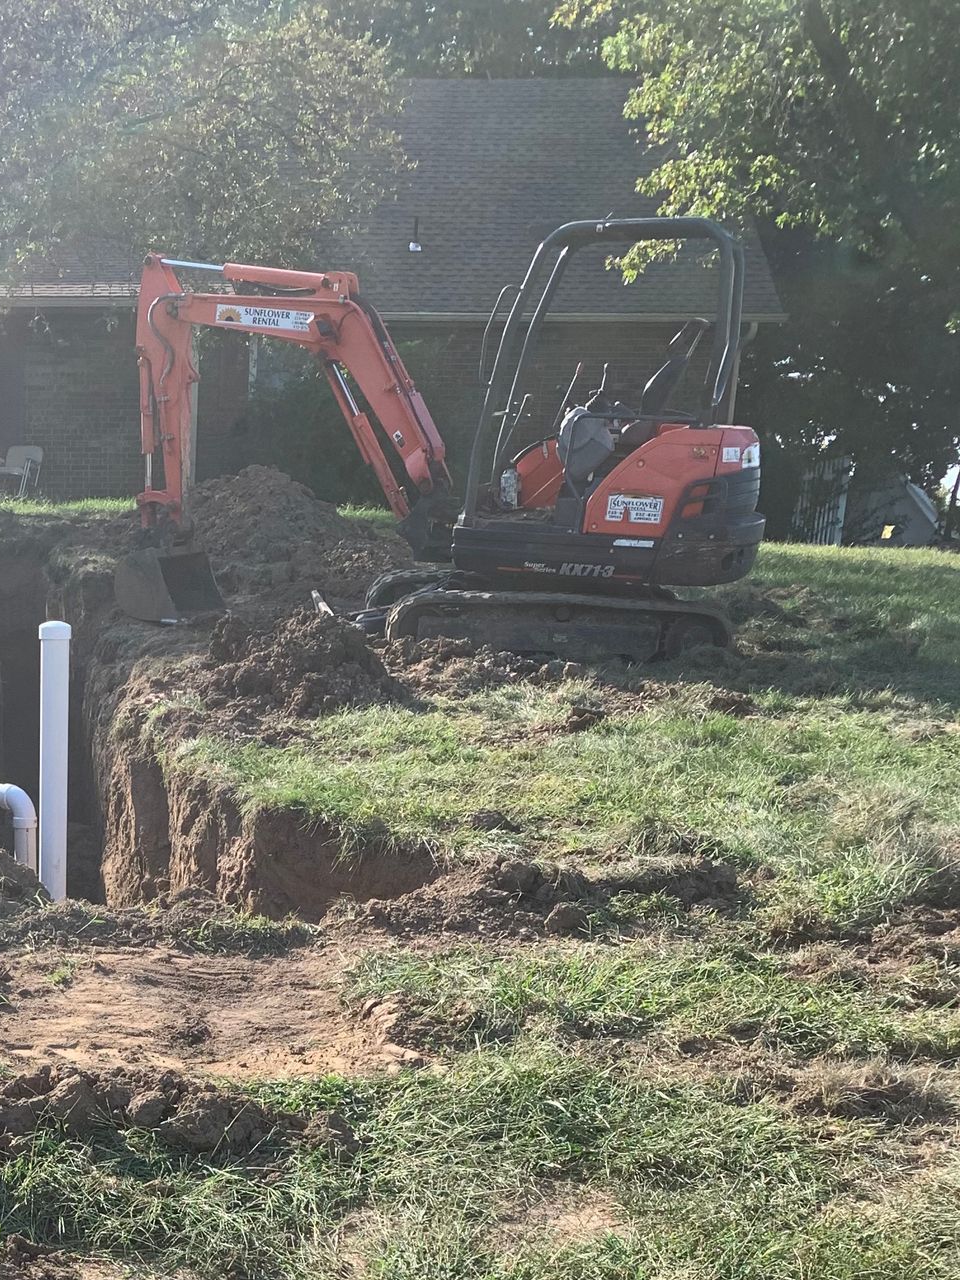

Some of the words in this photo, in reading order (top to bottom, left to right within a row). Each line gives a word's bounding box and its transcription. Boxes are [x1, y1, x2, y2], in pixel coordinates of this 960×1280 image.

[244, 308, 290, 319] SUNFLOWER
[252, 317, 280, 326] RENTAL
[612, 500, 659, 511] SUNFLOWER
[559, 563, 615, 578] KX71-3
